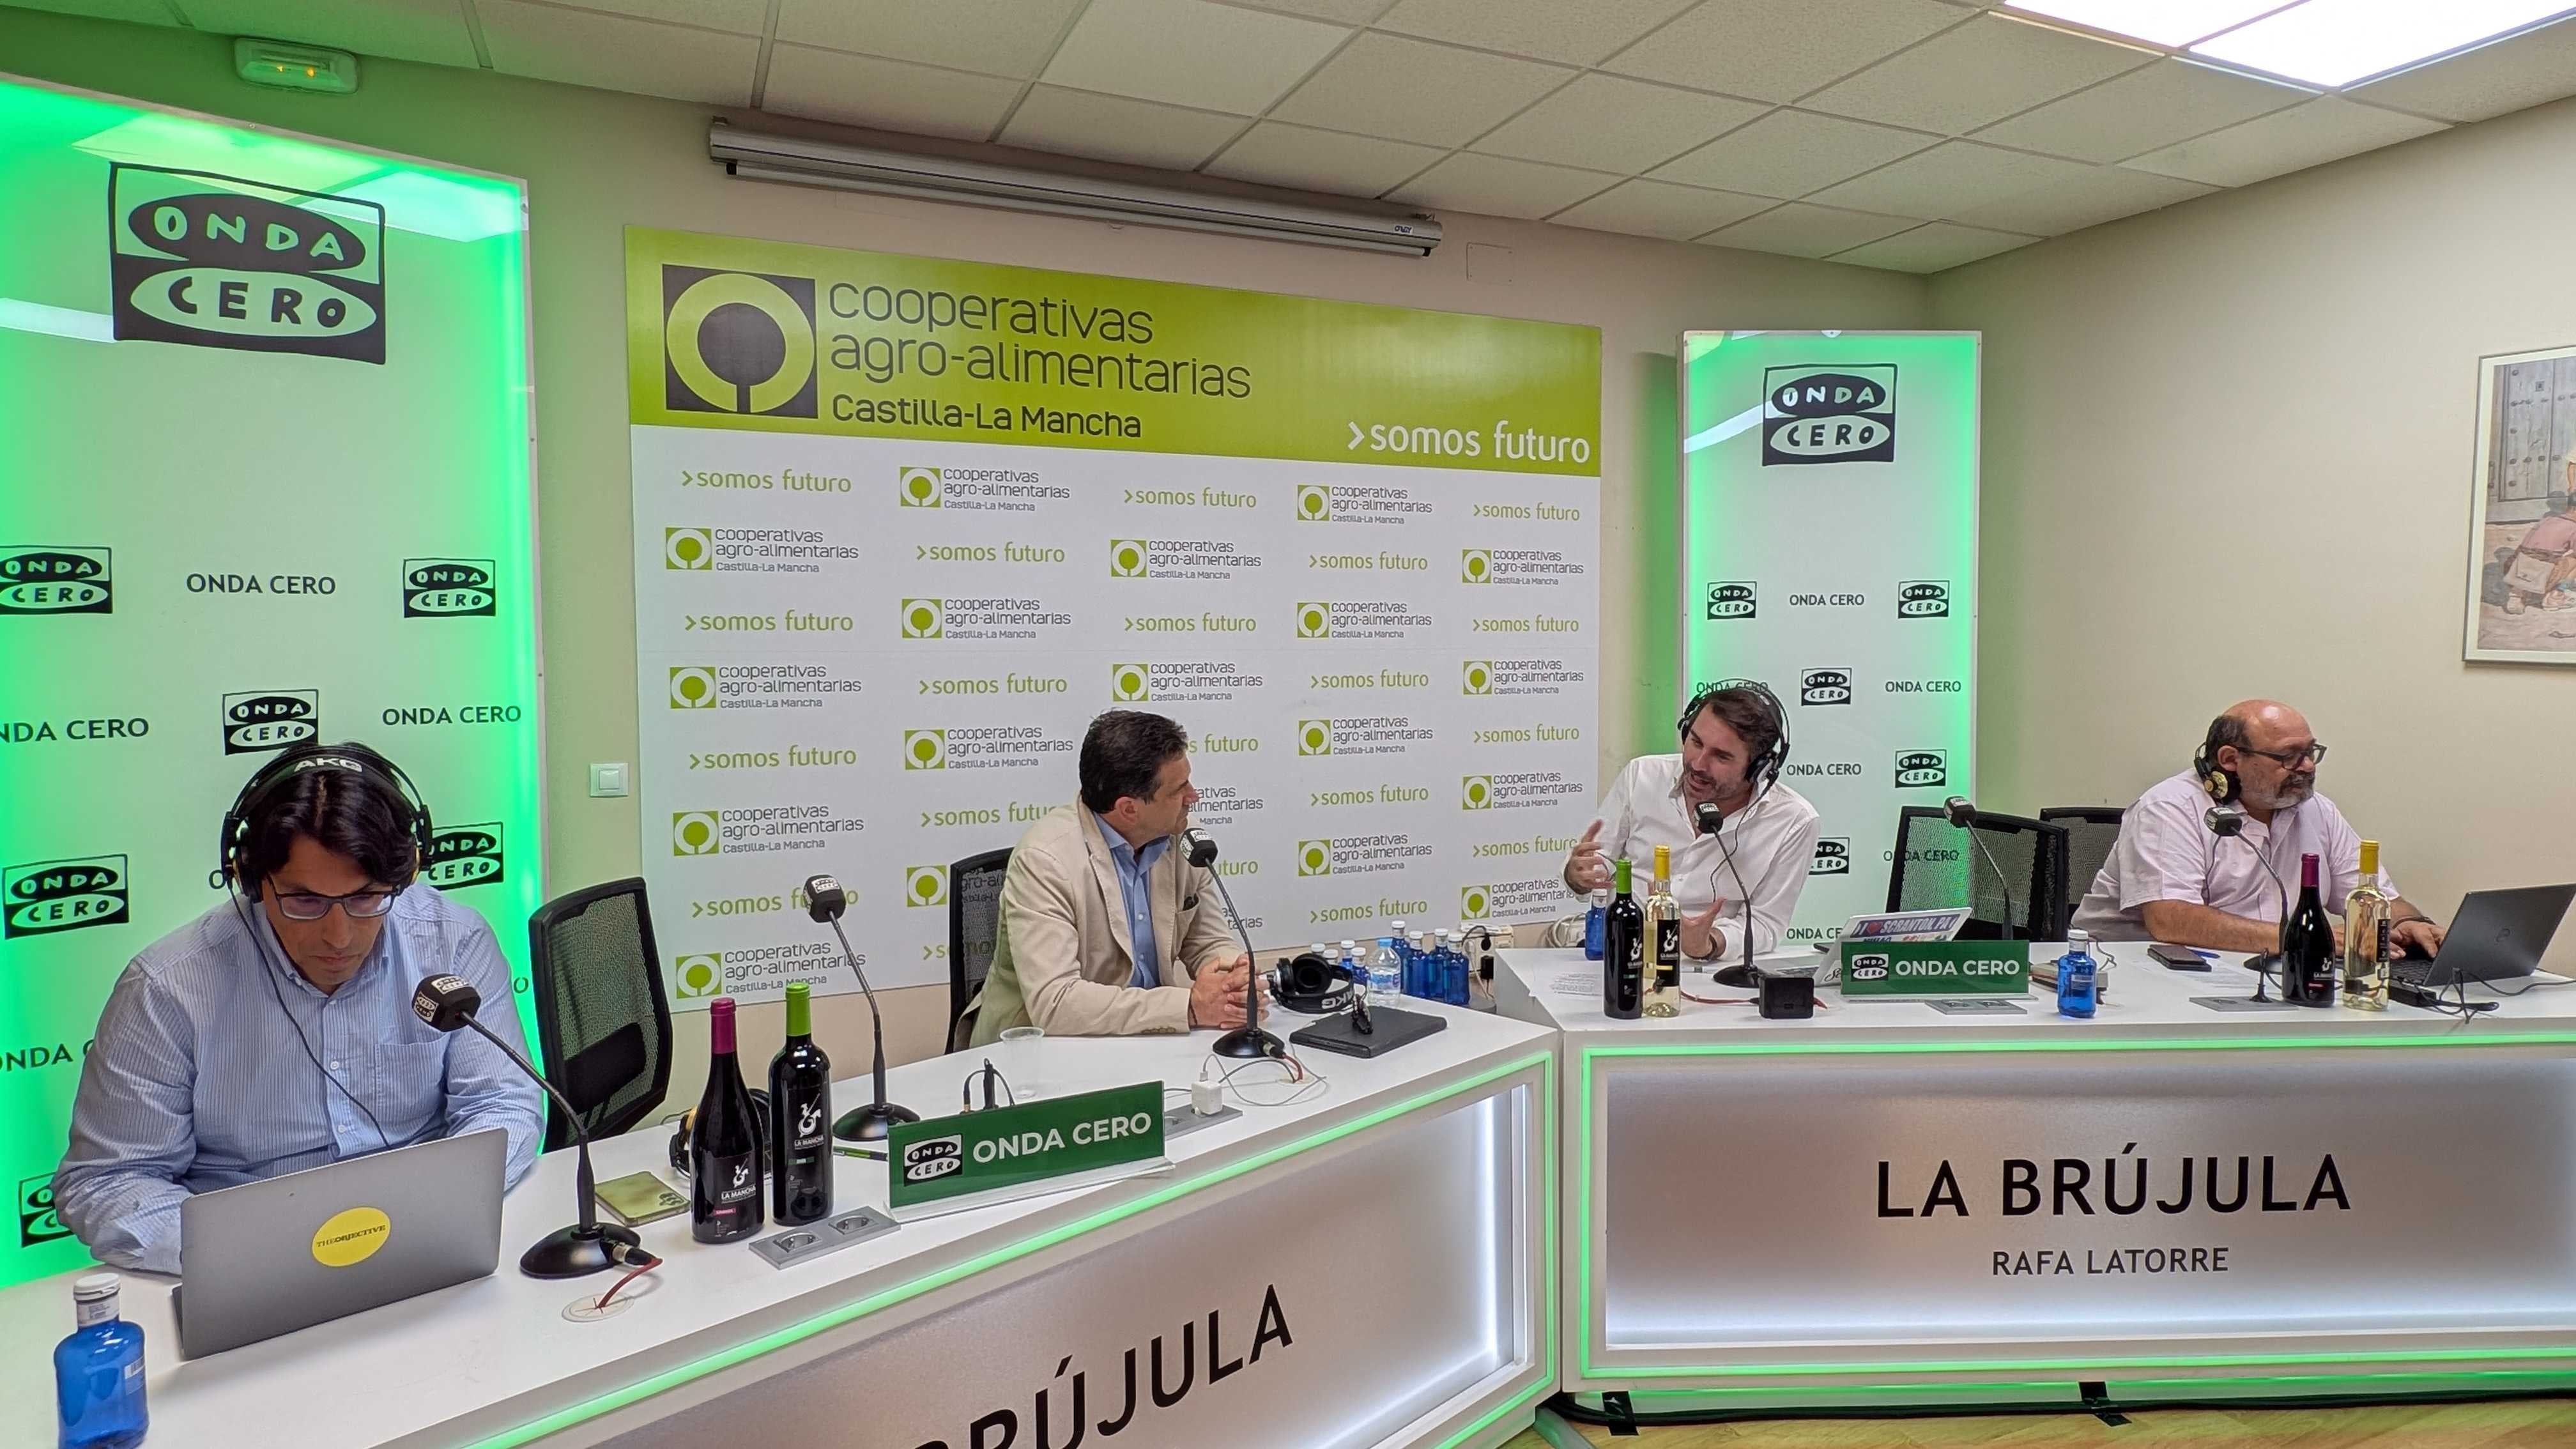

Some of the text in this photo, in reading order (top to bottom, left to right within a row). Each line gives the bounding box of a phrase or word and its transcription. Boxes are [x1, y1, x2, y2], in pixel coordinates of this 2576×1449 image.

[154, 206, 344, 261] ONDA
[168, 275, 347, 328] CERO
[829, 282, 1154, 344] cooperativas
[831, 332, 1252, 399] agro-alimentarias
[1782, 386, 1874, 407] ONDA
[832, 394, 1141, 438] Castilla-La Mancha
[1370, 420, 1590, 464] somos futuro
[1788, 424, 1874, 447] CERO
[697, 468, 852, 493] somos futuro
[944, 468, 1039, 484] cooperativas
[944, 483, 1070, 498] agro-alimentarias
[1135, 486, 1257, 508] somos futuro
[1331, 486, 1407, 499] cooperativas
[998, 502, 1035, 512] Mancha
[1331, 498, 1432, 513] agro-alimentarias
[1483, 502, 1580, 521] somos futuro
[716, 528, 823, 543] cooperativas
[716, 544, 859, 560] agro-alimentarias
[930, 541, 1065, 563] somos futuro
[1149, 540, 1234, 553] cooperativas
[1149, 553, 1261, 567] agro-alimentarias
[1319, 551, 1428, 571] somos futuro
[1493, 550, 1561, 562] cooperativas
[5, 560, 93, 575] ONDA
[778, 563, 819, 573] Mancha
[187, 574, 336, 595] ONDA CERO
[416, 570, 483, 583] ONDA
[12, 586, 94, 604] CERO
[421, 592, 483, 607] CERO
[1714, 589, 1749, 598] ONDA
[1790, 594, 1864, 606] ONDA CERO
[1905, 588, 1942, 597] ONDA
[945, 598, 1040, 611] cooperativas
[1331, 602, 1407, 614] cooperativas
[1717, 603, 1749, 613] CERO
[1908, 602, 1942, 611] CERO
[700, 609, 854, 631] somos futuro
[945, 612, 1071, 627] agro-alimentarias
[1137, 612, 1257, 632] somos futuro
[1331, 613, 1432, 627] agro-alimentarias
[1482, 615, 1579, 632] somos futuro
[999, 631, 1036, 639] Mancha
[719, 665, 826, 680] cooperativas
[1151, 662, 1235, 675] cooperativas
[1494, 659, 1562, 671] cooperativas
[933, 673, 1068, 694] somos futuro
[1151, 675, 1262, 690] agro-alimentarias
[1321, 669, 1429, 688] somos futuro
[1807, 674, 1844, 684] ONDA
[1885, 680, 1961, 693] ONDA CERO
[719, 679, 861, 696] agro-alimentarias
[1811, 689, 1843, 700] CERO
[236, 702, 305, 717] ONDA
[781, 698, 822, 708] Mancha
[383, 705, 522, 725] ONDA CERO
[1333, 716, 1408, 730] cooperativas
[66, 718, 149, 739] CERO
[243, 725, 305, 742] CERO
[947, 726, 1042, 741] cooperativas
[1333, 728, 1433, 744] agro-alimentarias
[1483, 723, 1579, 742] somos futuro
[947, 739, 1073, 756] agro-alimentarias
[1205, 733, 1258, 753] futuro
[295, 758, 362, 772] AKG
[705, 745, 857, 769] somos futuro
[1002, 758, 1038, 767] Mancha
[1903, 756, 1939, 766] ONDA
[1786, 764, 1862, 776] ONDA CERO
[1905, 771, 1938, 781] CERO
[1493, 772, 1561, 785] cooperativas
[1321, 785, 1429, 805] somos futuro
[722, 805, 829, 823] cooperativas
[934, 808, 1000, 826] somos
[723, 818, 864, 840] agro-alimentarias
[784, 839, 825, 850] Mancha
[1333, 834, 1408, 849] cooperativas
[1482, 841, 1529, 856] somos
[1333, 845, 1432, 863] agro-alimentarias
[428, 862, 489, 880] CERO
[20, 872, 109, 893] ONDA
[28, 900, 109, 921] CERO
[707, 895, 782, 917] somos
[1321, 898, 1427, 922] somos futuro
[1786, 928, 1823, 940] ONDA
[724, 942, 831, 963] cooperativas
[1896, 960, 2020, 976] ONDA CERO
[973, 1112, 1152, 1163] ONDA CERO
[912, 1144, 954, 1159] ONDA
[915, 1160, 954, 1177] CERO
[1877, 1142, 2351, 1218] LA BRÚJULA
[721, 1191, 730, 1199] LA
[1993, 1246, 2230, 1276] RAFA LATORRE
